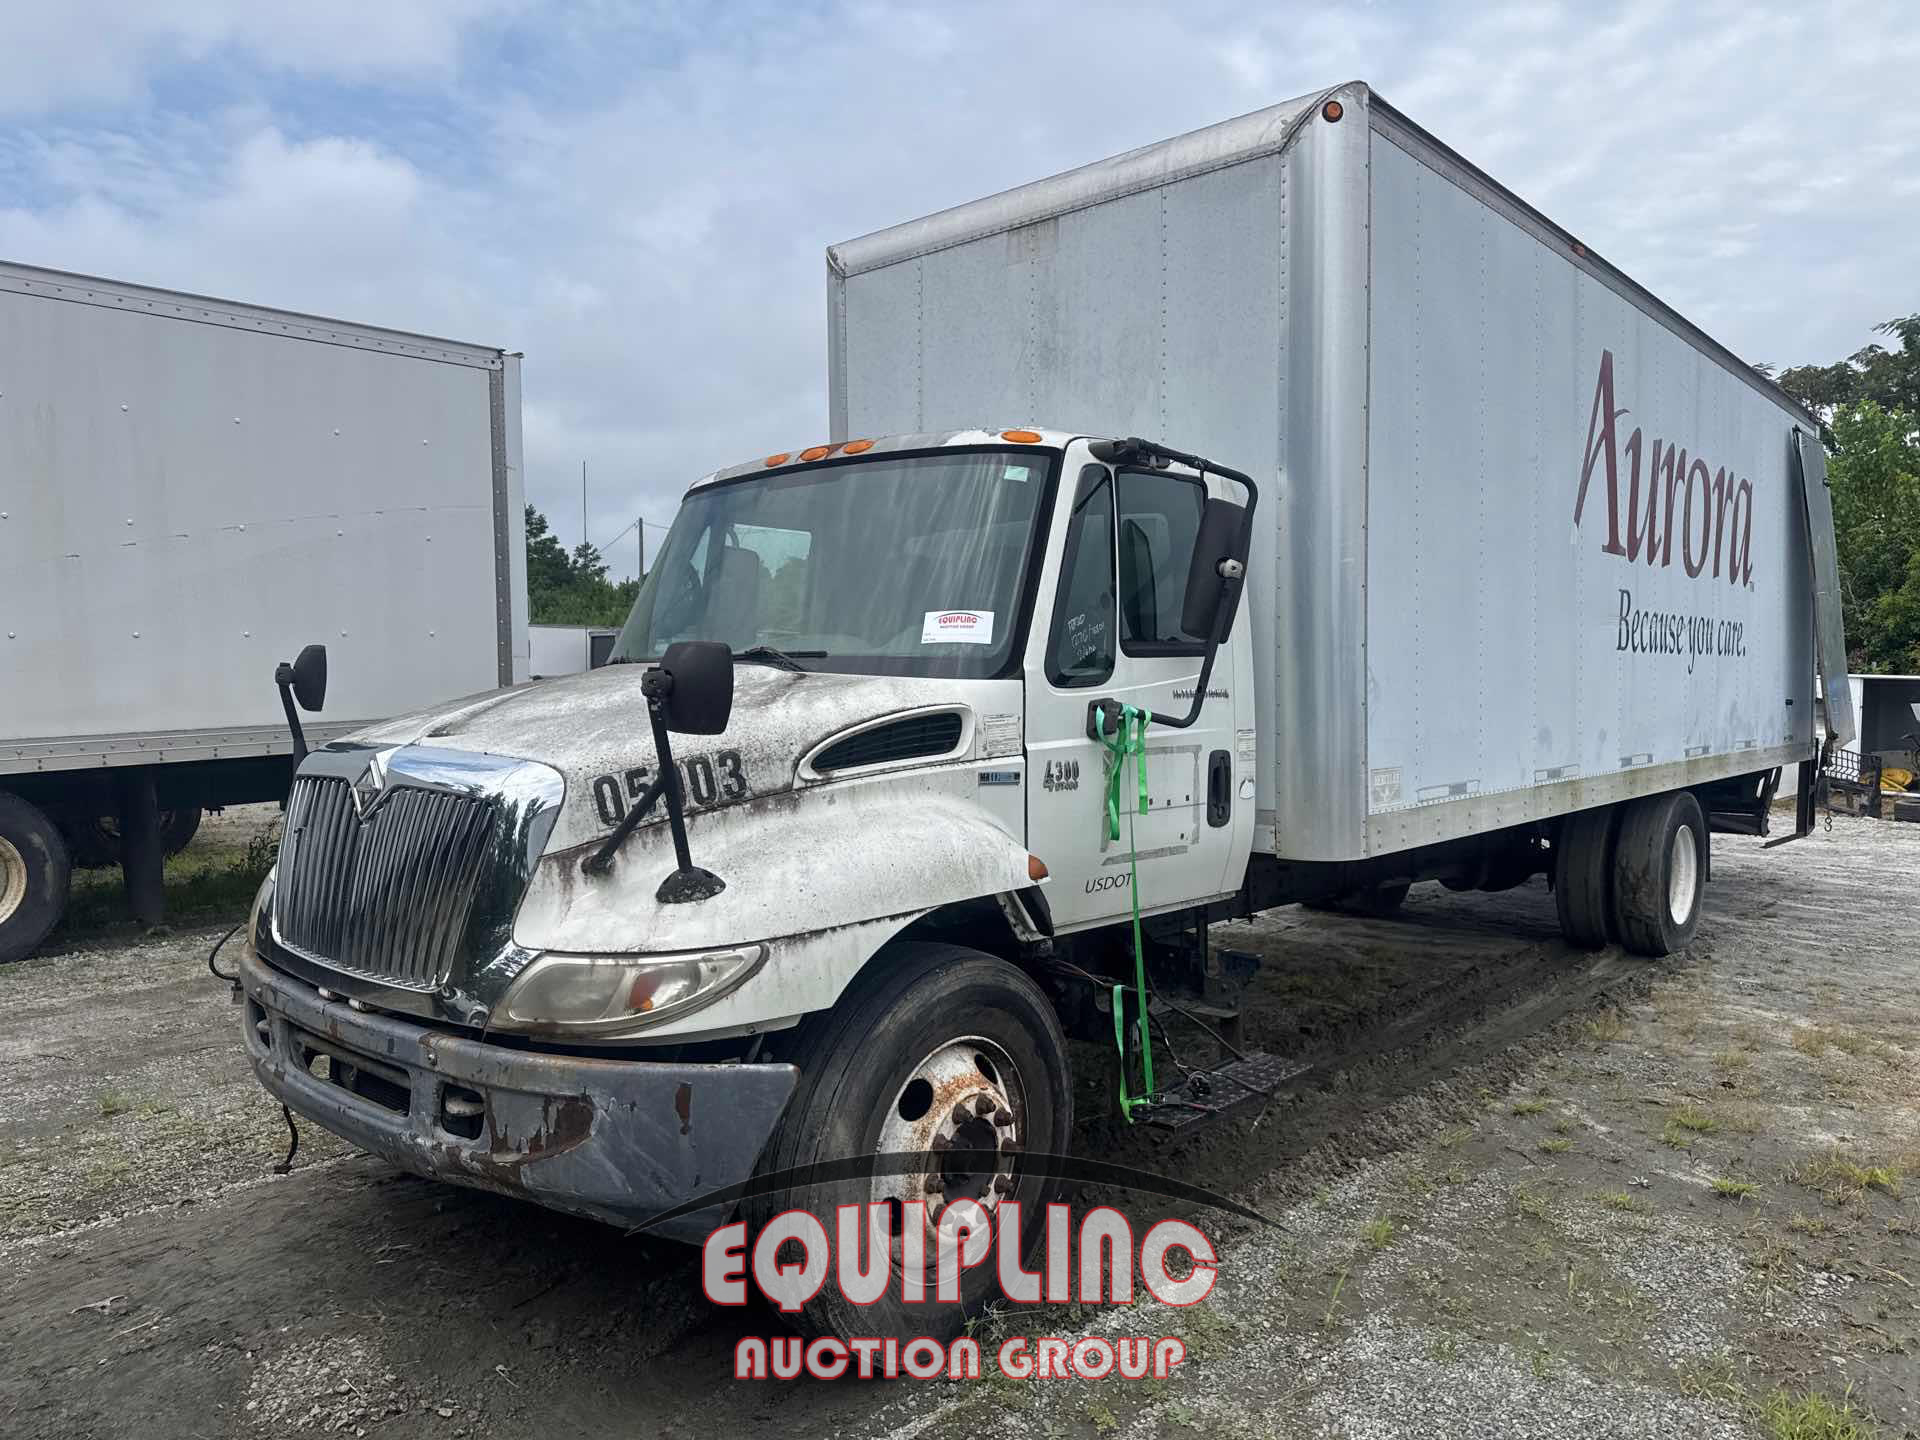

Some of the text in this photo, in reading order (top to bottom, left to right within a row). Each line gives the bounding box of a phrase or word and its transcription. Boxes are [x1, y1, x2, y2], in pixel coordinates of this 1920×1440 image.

[1574, 349, 1754, 588] Aurora
[1616, 588, 1747, 674] Because you care.
[1085, 872, 1133, 894] USDOT
